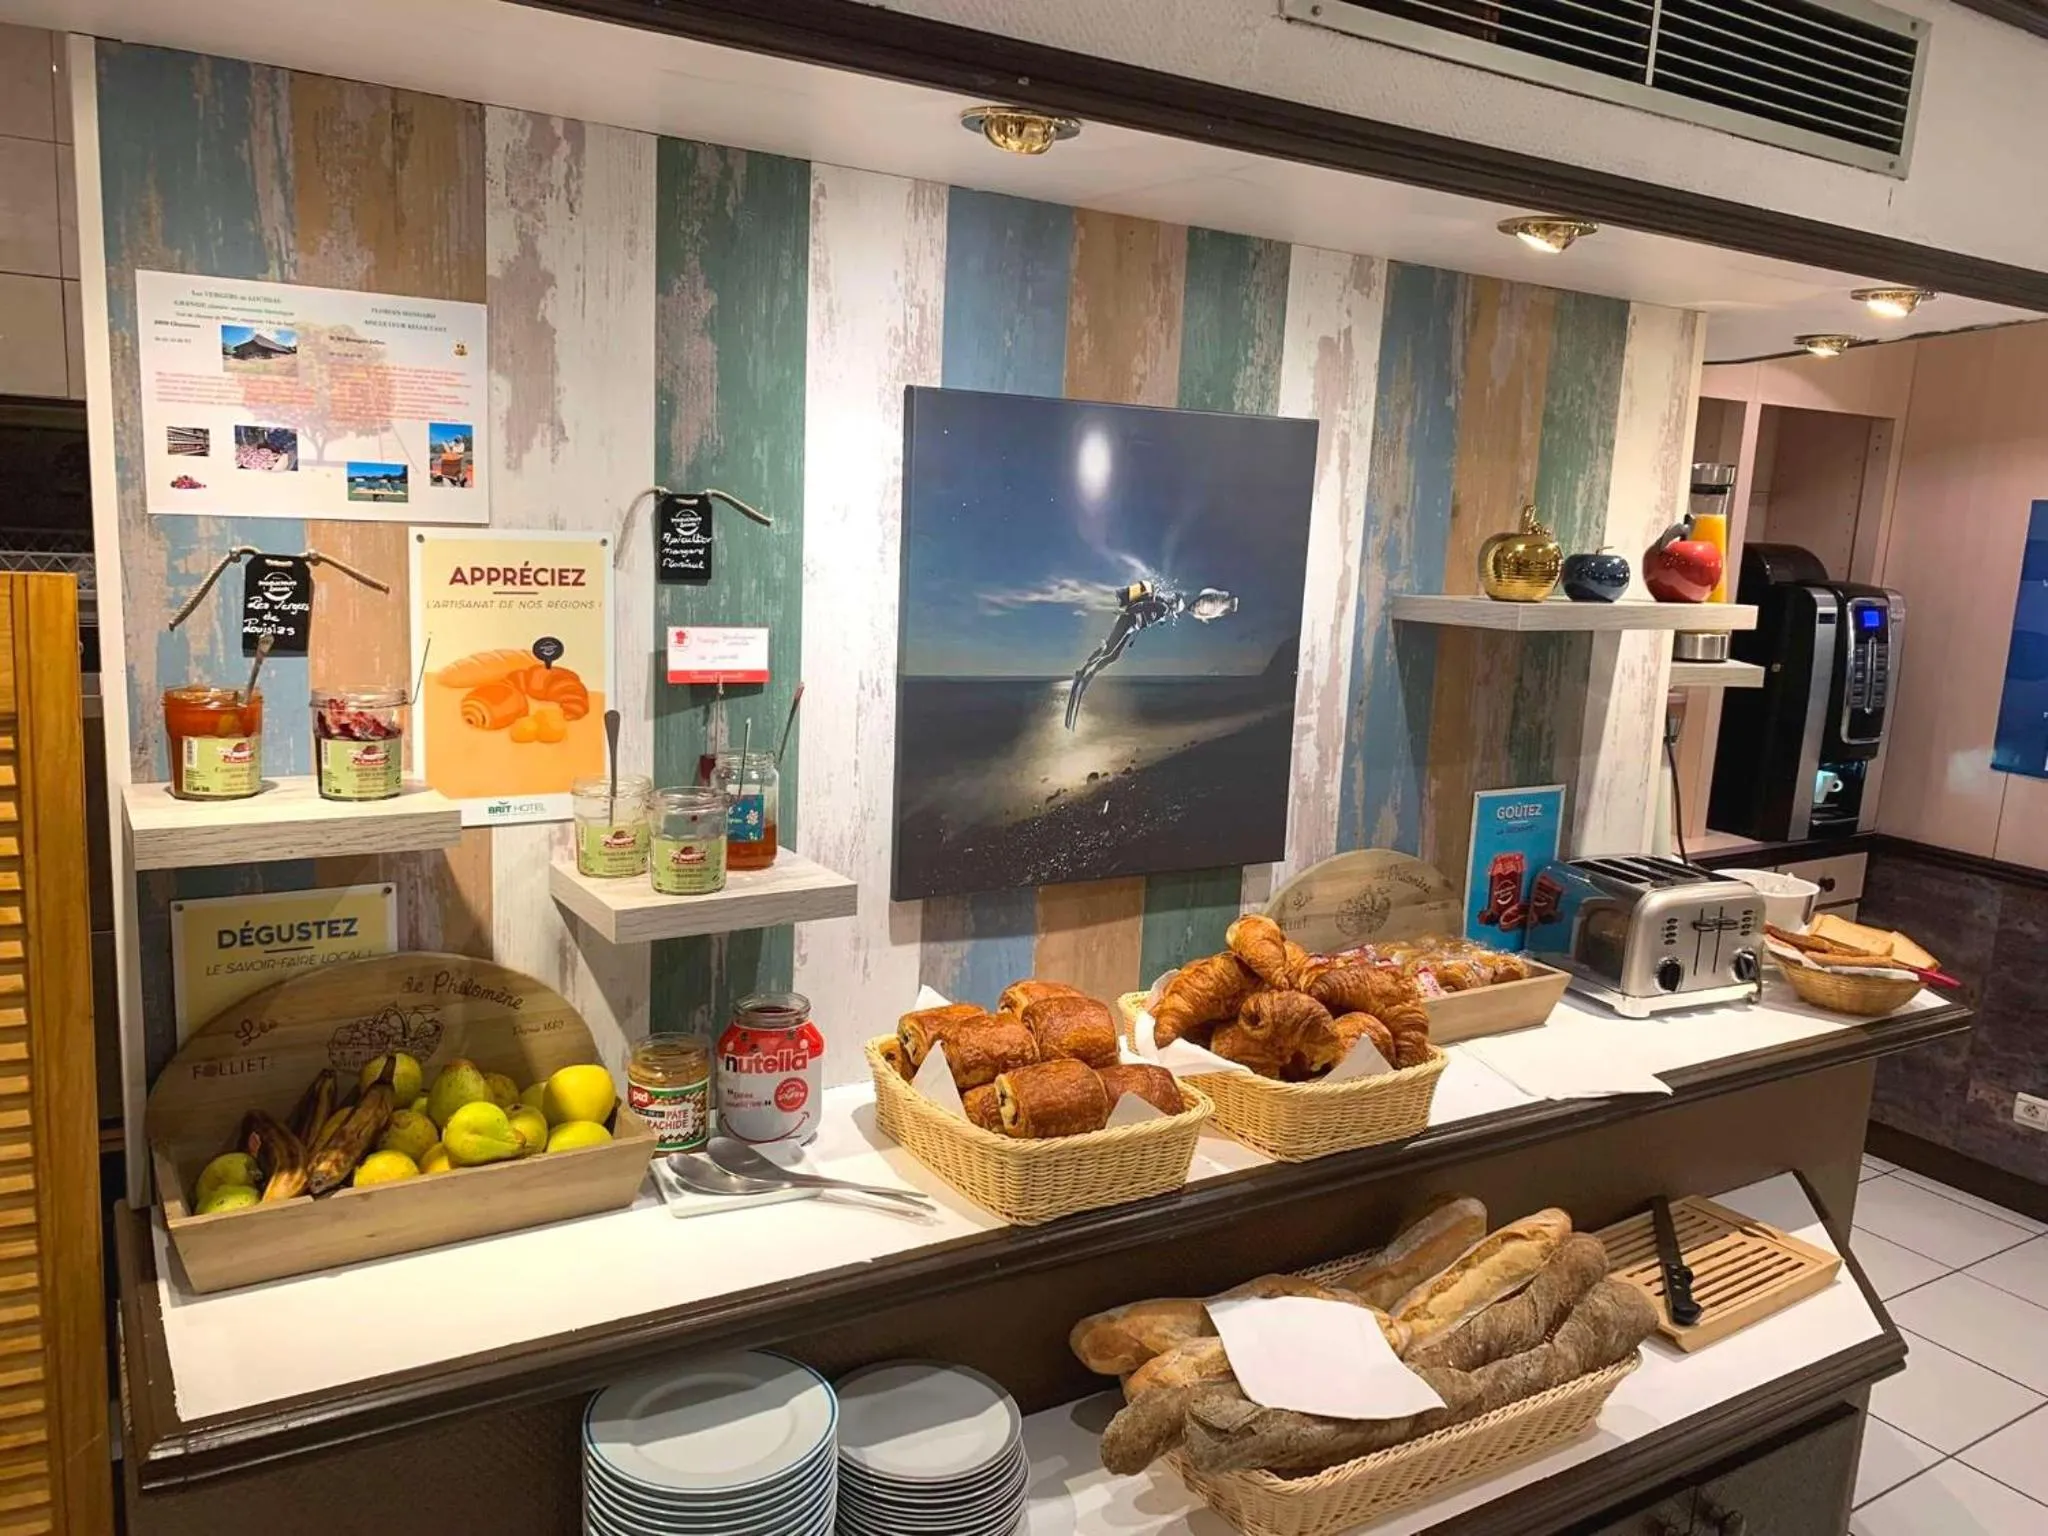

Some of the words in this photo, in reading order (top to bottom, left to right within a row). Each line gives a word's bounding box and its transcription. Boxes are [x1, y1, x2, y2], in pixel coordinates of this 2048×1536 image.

[449, 560, 586, 587] APPRÉCIEZ
[426, 600, 495, 609] L'ARTISANAT
[499, 600, 514, 609] DE
[519, 600, 543, 609] NOS
[1496, 802, 1543, 820] GOÛTEZ
[217, 917, 359, 949] DÉGUSTEZ
[205, 964, 221, 977] LE
[224, 953, 316, 975] SAVOIR-FAIRE
[321, 950, 362, 965] LOCAL
[433, 970, 525, 1011] Philomène
[725, 1050, 809, 1075] nutella
